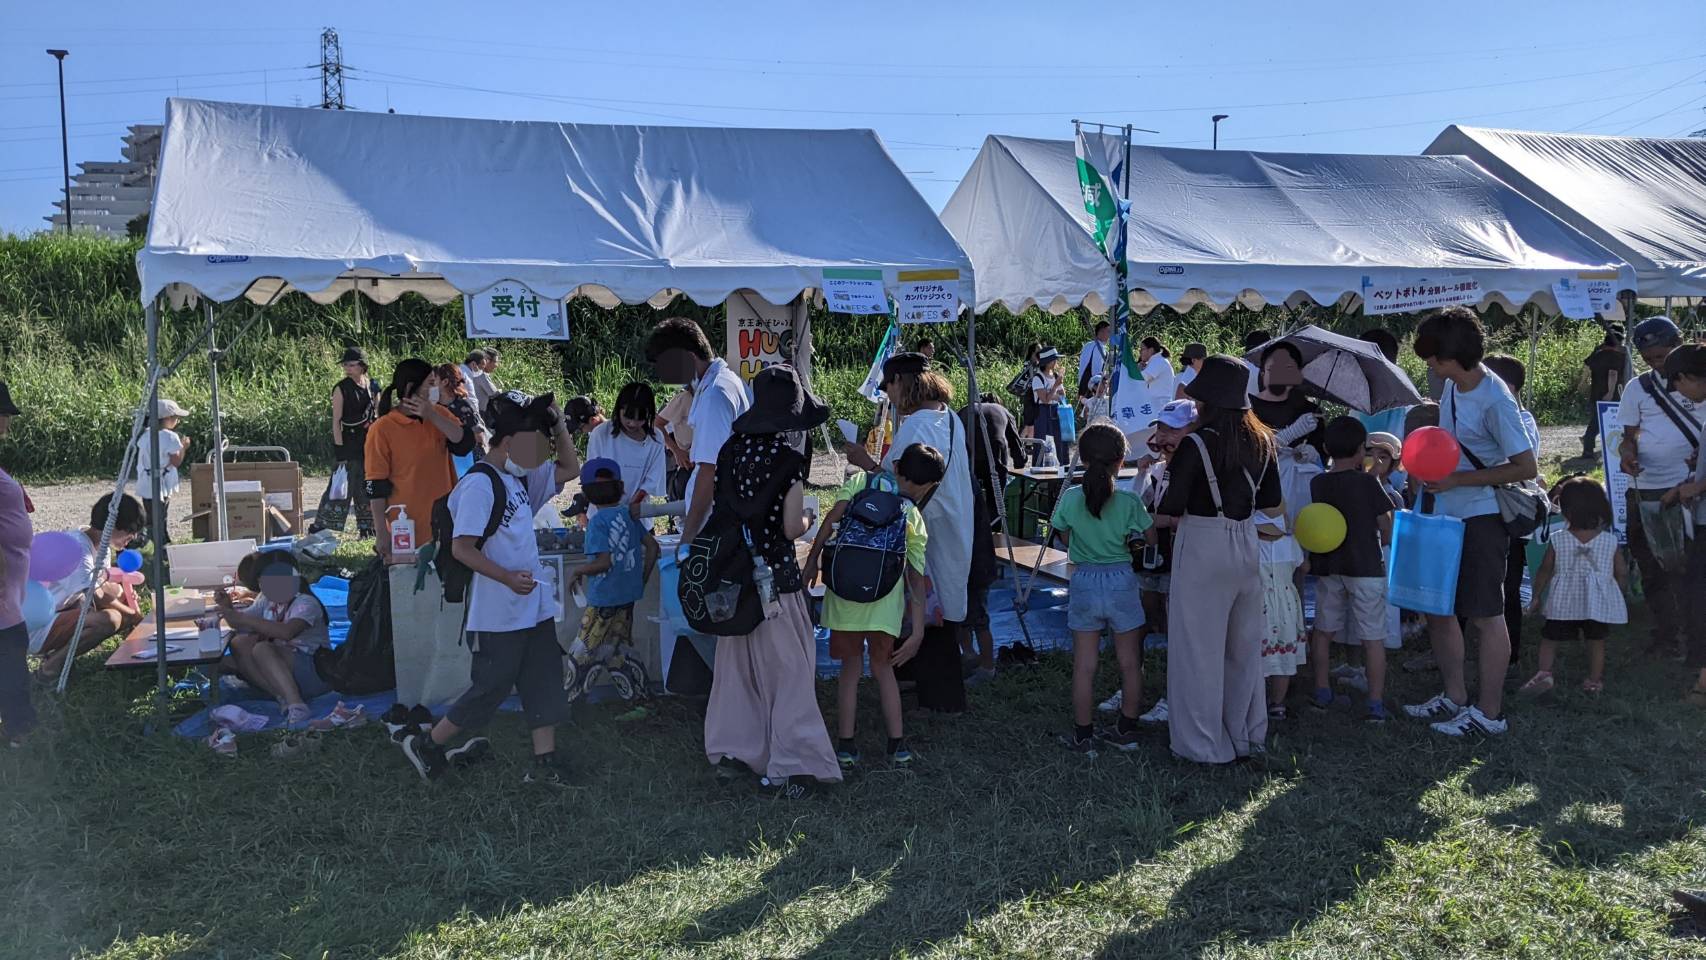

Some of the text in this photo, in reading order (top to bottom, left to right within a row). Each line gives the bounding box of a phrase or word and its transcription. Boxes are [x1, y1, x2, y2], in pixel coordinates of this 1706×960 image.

[913, 285, 944, 293] オリジナル
[491, 294, 541, 318] 受付
[737, 318, 793, 328] 京王あそびの
